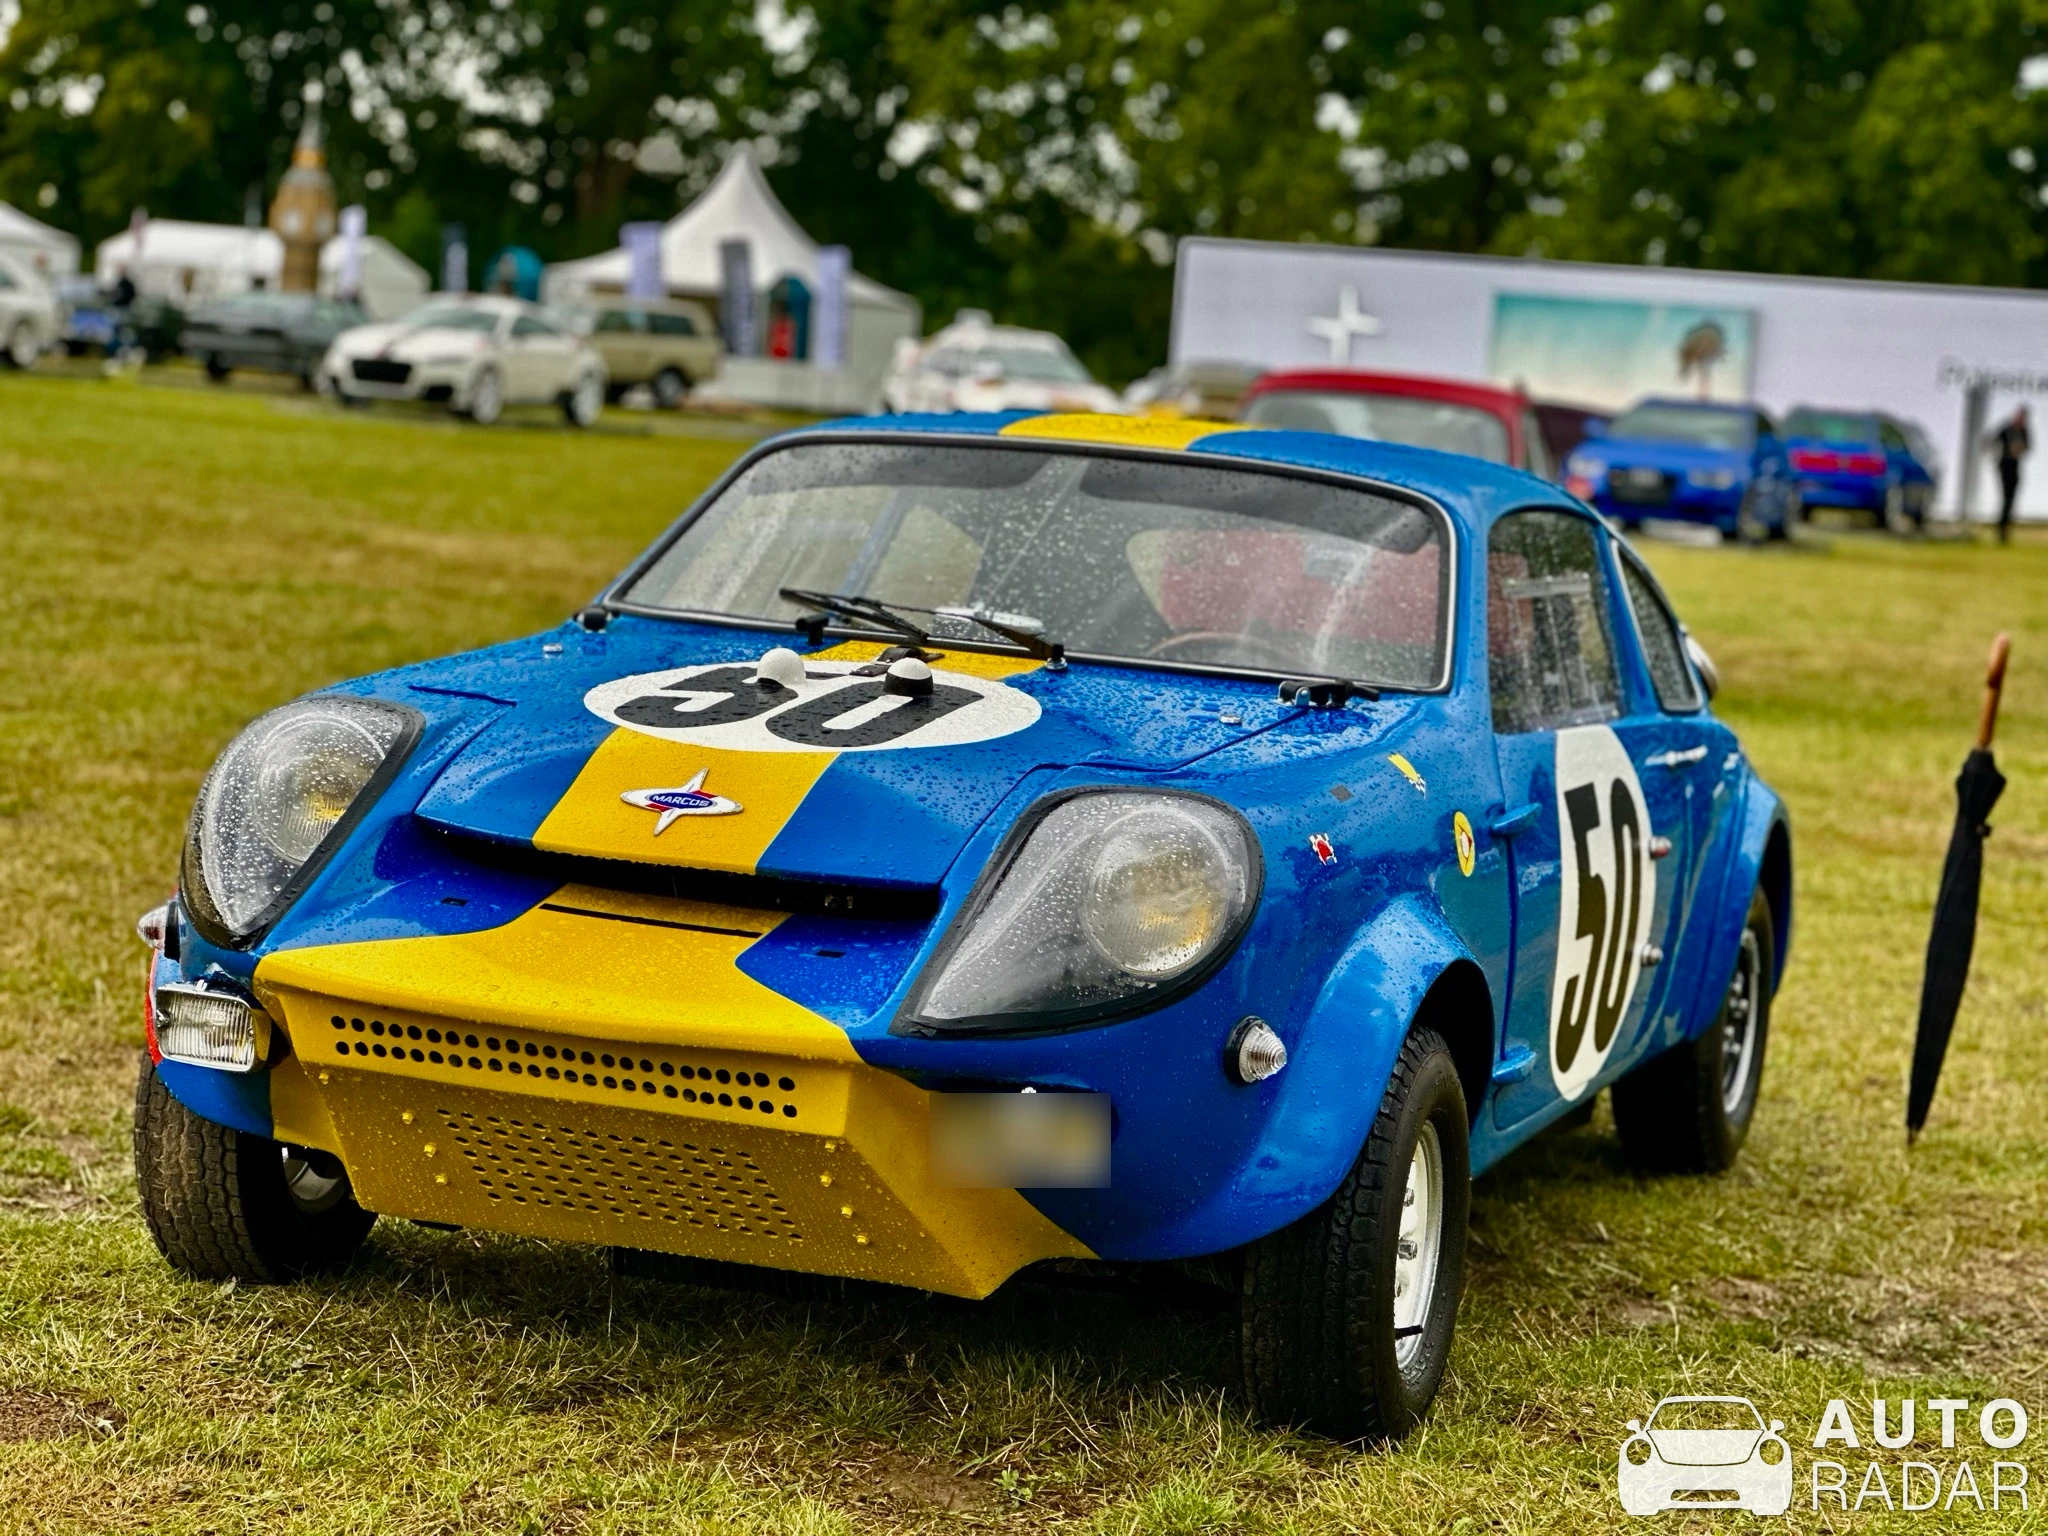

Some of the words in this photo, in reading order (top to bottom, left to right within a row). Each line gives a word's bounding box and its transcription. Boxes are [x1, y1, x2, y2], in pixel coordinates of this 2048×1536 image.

[613, 667, 985, 748] 50
[652, 795, 710, 807] MARCOS
[1555, 777, 1642, 1074] 50
